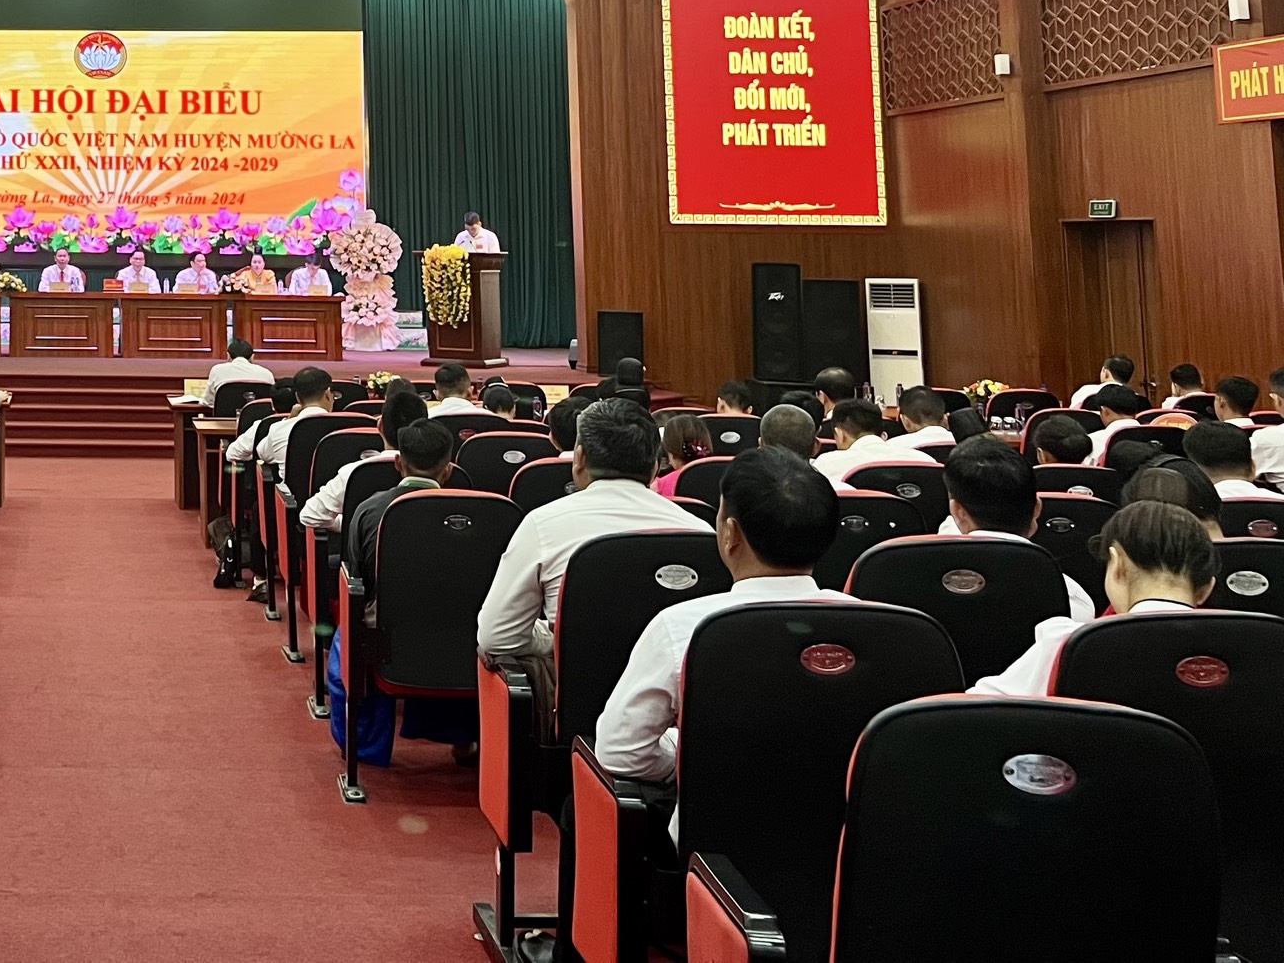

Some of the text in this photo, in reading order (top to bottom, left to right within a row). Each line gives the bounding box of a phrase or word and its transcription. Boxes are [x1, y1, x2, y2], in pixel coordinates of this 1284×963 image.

[723, 9, 815, 42] ĐOÀN KẾT,
[728, 44, 814, 77] DÂN CHỦ,
[733, 78, 811, 113] ĐỔI MỚI,
[1229, 61, 1269, 100] PHÁT
[31, 85, 96, 121] HỘI
[106, 90, 169, 121] ĐẠI
[11, 128, 68, 149] QUỐC
[72, 130, 119, 151] VIỆT
[123, 133, 167, 147] NAM
[173, 131, 241, 152] HUYỆN
[247, 132, 324, 150] MƯỜNG
[329, 135, 356, 149] LA
[722, 114, 827, 147] PHÁT TRIỂN
[35, 155, 82, 172] XXII,
[86, 154, 152, 174] NHIỆM
[158, 153, 186, 171] KỲ
[190, 156, 229, 172] 2024
[32, 190, 55, 205] La,
[58, 191, 93, 207] ngày
[96, 191, 115, 204] 27
[117, 191, 159, 207] tháng
[163, 192, 171, 205] 5
[175, 192, 207, 205] năm
[211, 192, 246, 205] 2024
